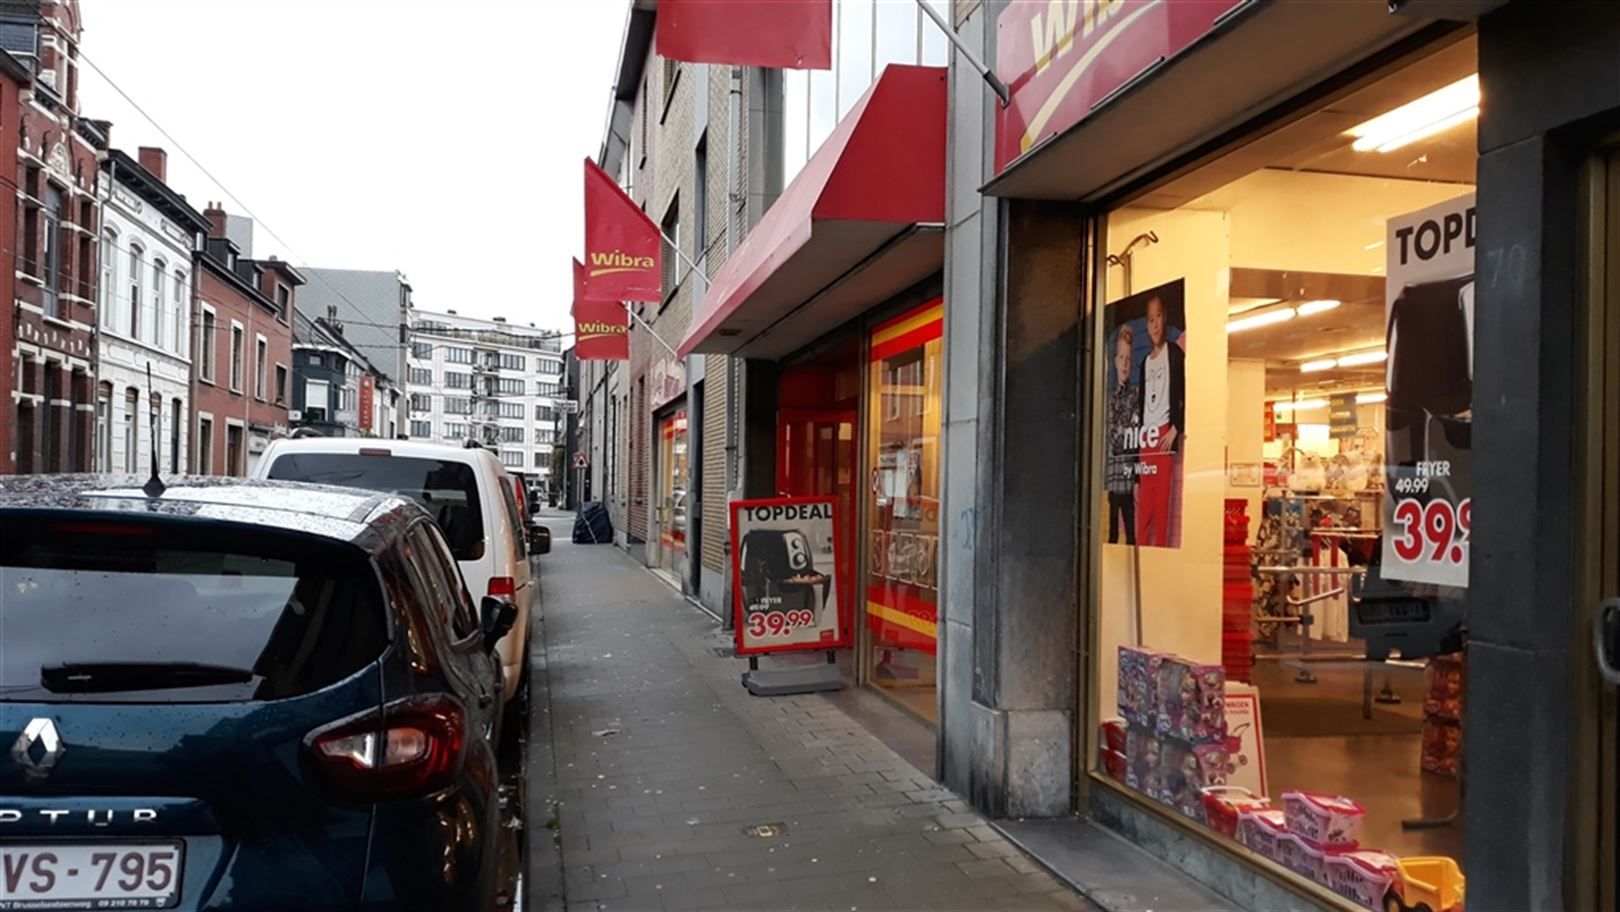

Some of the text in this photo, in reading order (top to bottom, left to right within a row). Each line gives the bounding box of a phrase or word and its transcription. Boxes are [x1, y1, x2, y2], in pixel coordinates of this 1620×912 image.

[591, 250, 654, 267] Wibra
[578, 320, 627, 334] Wibra
[1123, 424, 1160, 450] nice
[1134, 461, 1157, 474] Wibra
[1416, 461, 1451, 477] FRYER
[1395, 478, 1429, 494] 49.99
[744, 503, 833, 522] TOPDEAL
[749, 610, 813, 638] 39.99
